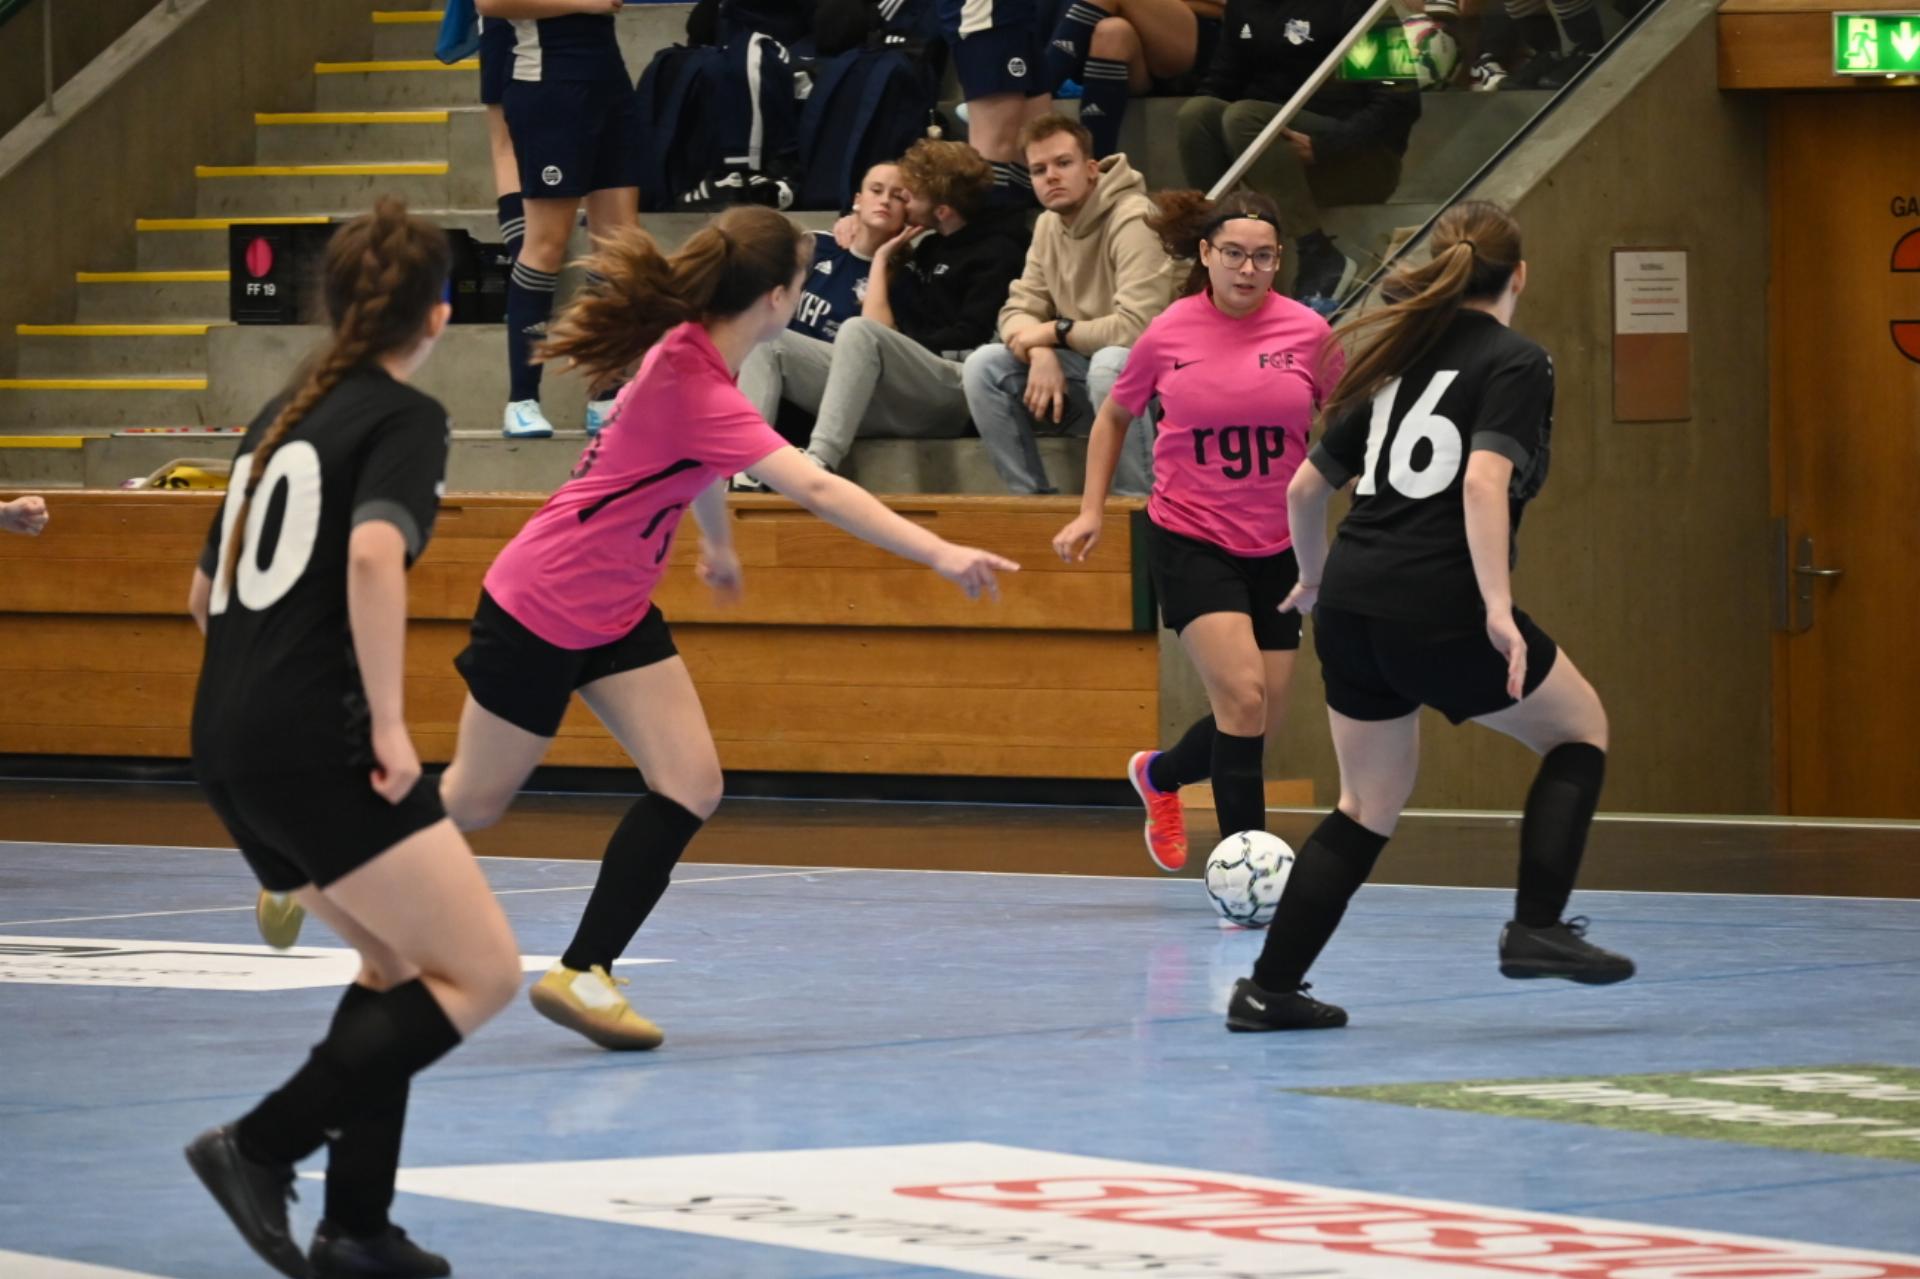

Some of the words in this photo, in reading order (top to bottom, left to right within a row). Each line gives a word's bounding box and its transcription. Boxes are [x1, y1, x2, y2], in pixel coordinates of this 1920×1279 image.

[246, 283, 261, 296] FF
[263, 283, 276, 296] 19
[1192, 425, 1286, 480] rgp
[1355, 370, 1463, 499] 16
[209, 440, 322, 616] 10
